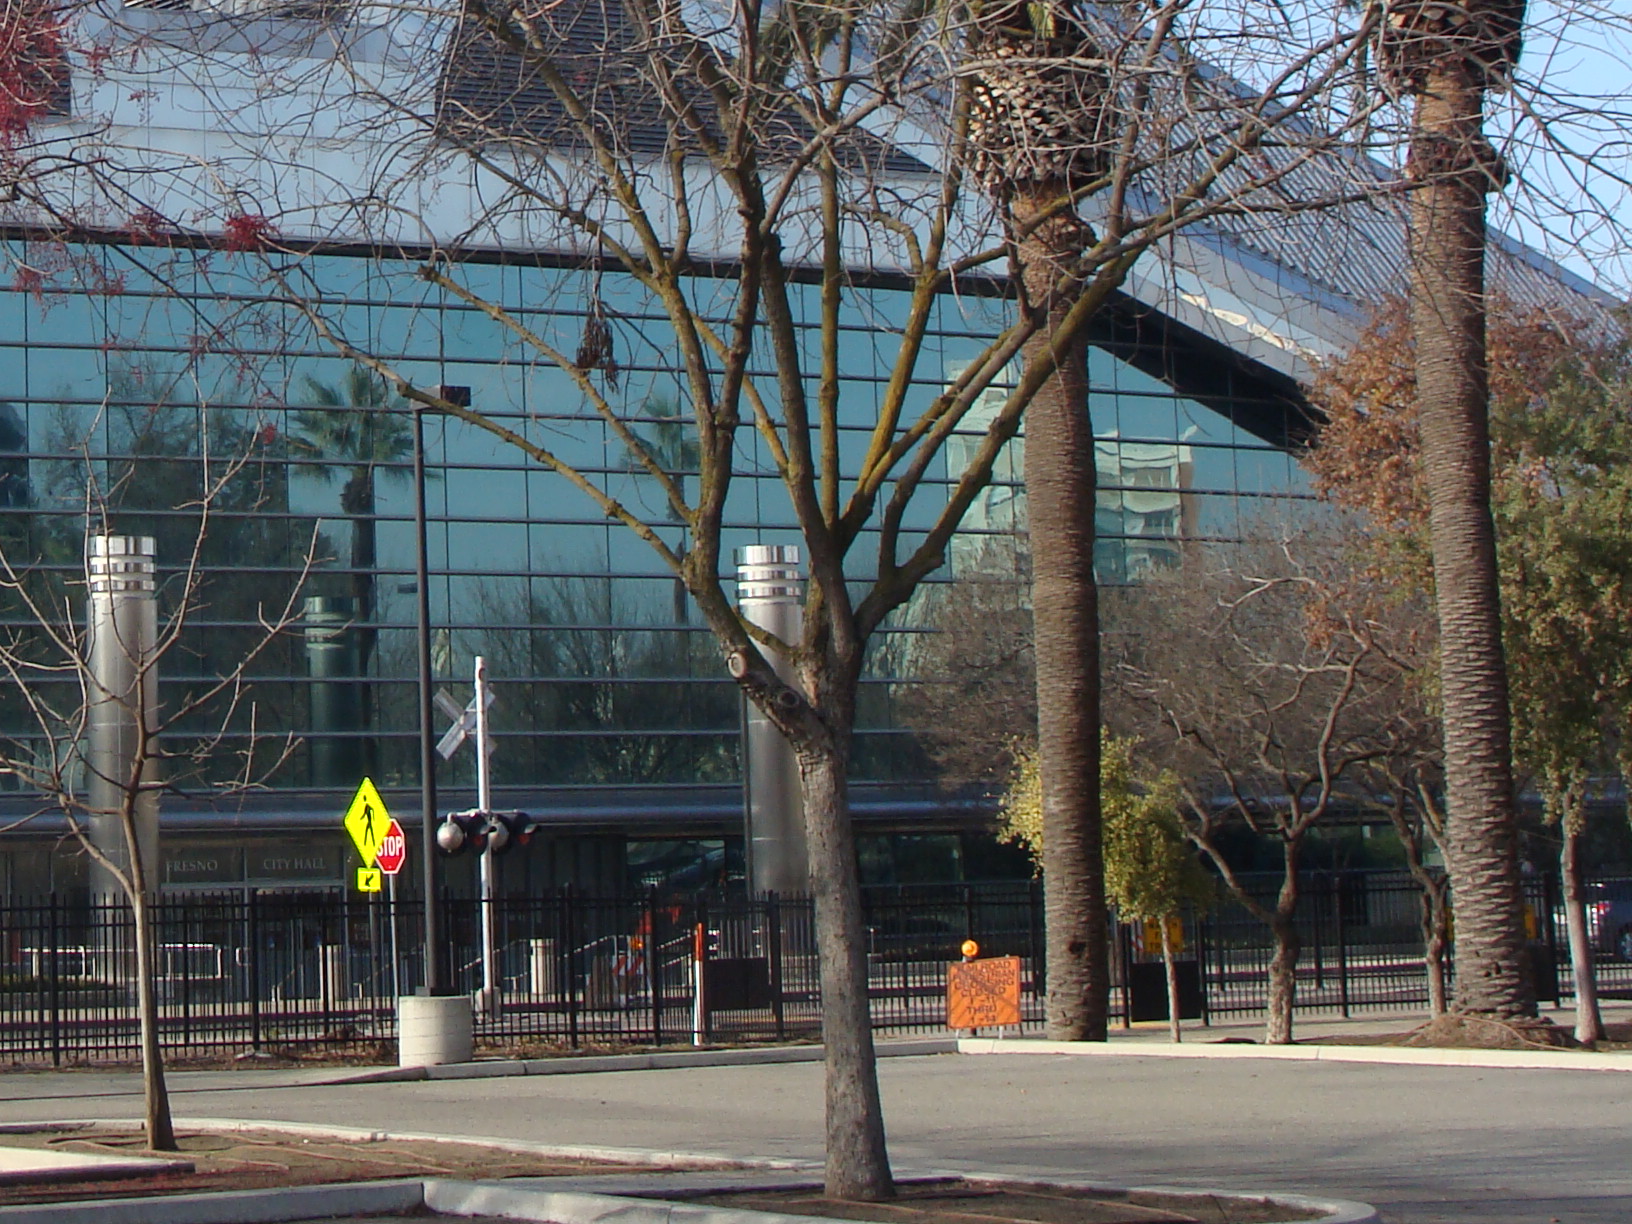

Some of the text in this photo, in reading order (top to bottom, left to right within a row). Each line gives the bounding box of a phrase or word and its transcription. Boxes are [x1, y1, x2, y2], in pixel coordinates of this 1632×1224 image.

[376, 835, 403, 857] STOP
[166, 859, 218, 873] FRESNO
[263, 857, 326, 870] CITY HALL
[952, 968, 1016, 983] PSTRIAN
[954, 978, 1015, 991] COSING
[960, 986, 1006, 997] CLOD
